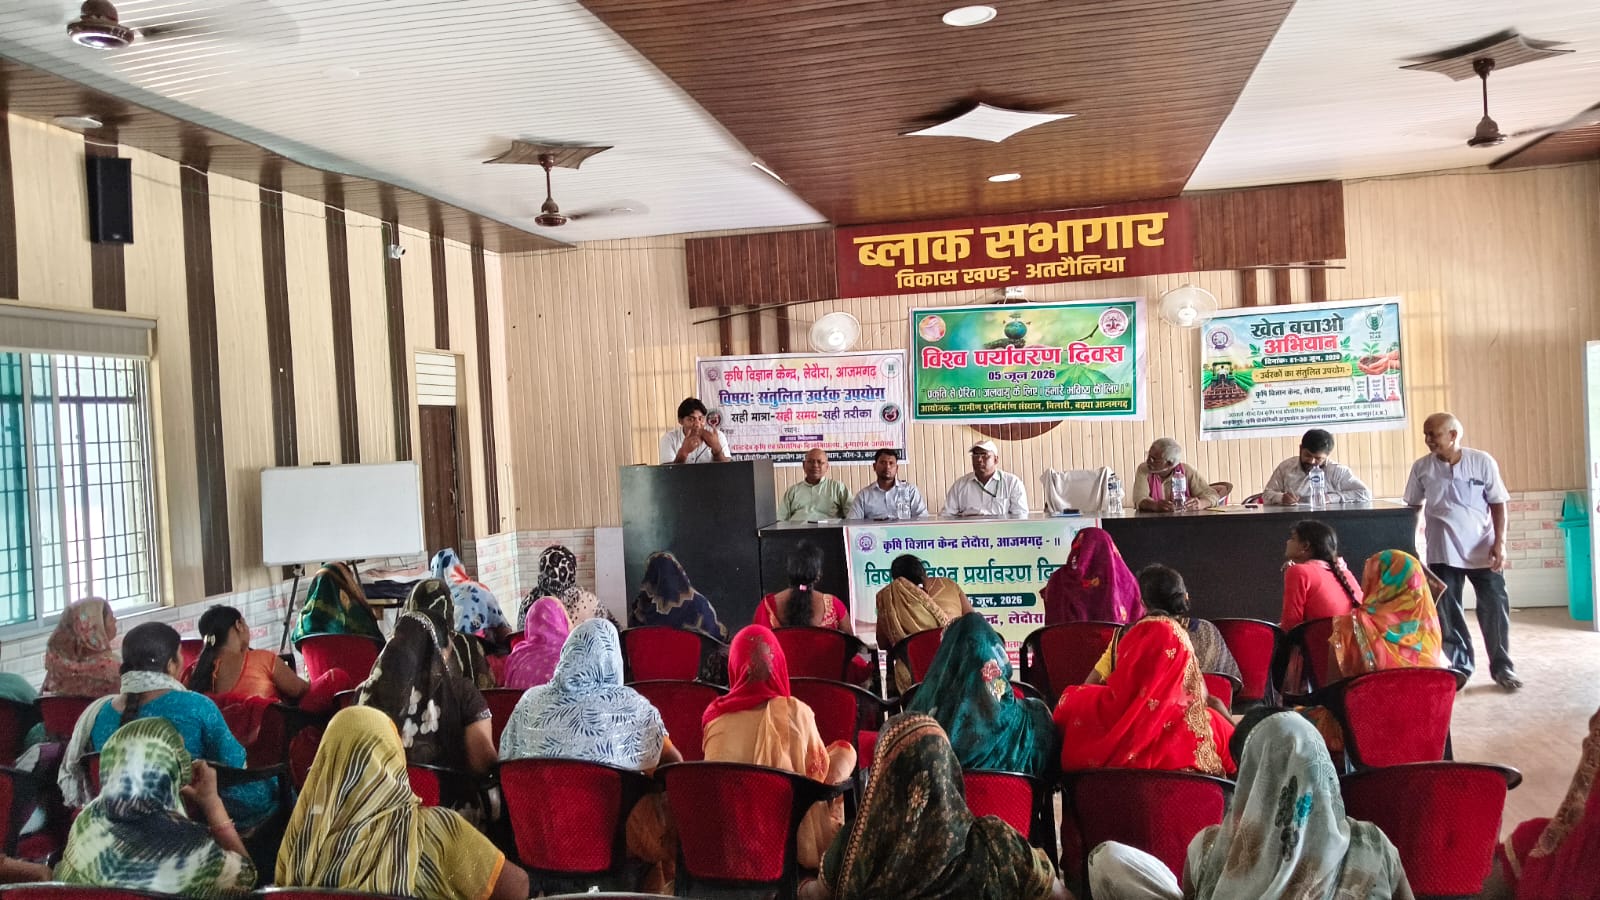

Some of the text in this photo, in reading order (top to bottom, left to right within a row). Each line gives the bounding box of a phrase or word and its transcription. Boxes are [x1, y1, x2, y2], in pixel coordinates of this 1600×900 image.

[853, 212, 1169, 267] ब्लाक सभागार
[895, 268, 958, 288] विकास
[1026, 256, 1126, 280] अतरौलिया
[1251, 312, 1344, 338] खेत बचाओ
[1264, 333, 1338, 355] अभियान
[922, 341, 1125, 369] विश्व पर्यावरण दिवस
[724, 364, 743, 387] कृषि
[746, 364, 773, 383] विज्ञान
[776, 363, 800, 382] केन्द्र,
[836, 364, 877, 380] आजमगढ़
[988, 370, 1055, 384] 05 जून 2026
[1260, 364, 1345, 379] उर्वरकों का संतुलित उपयोग
[758, 386, 803, 407] संतुलित
[844, 384, 886, 402] उपयोग
[983, 388, 1011, 400] जलवायु
[1013, 386, 1020, 397] के
[1023, 384, 1038, 397] लिए
[1044, 385, 1064, 396] हमारे
[1255, 388, 1267, 398] कृषि
[731, 409, 747, 423] सही
[843, 405, 872, 419] तरीका
[883, 537, 902, 554] कृषि
[905, 537, 934, 551] विज्ञान
[937, 535, 958, 549] केन्द्र
[996, 536, 1043, 550] आजमगढ़
[1000, 595, 1022, 606] 2026
